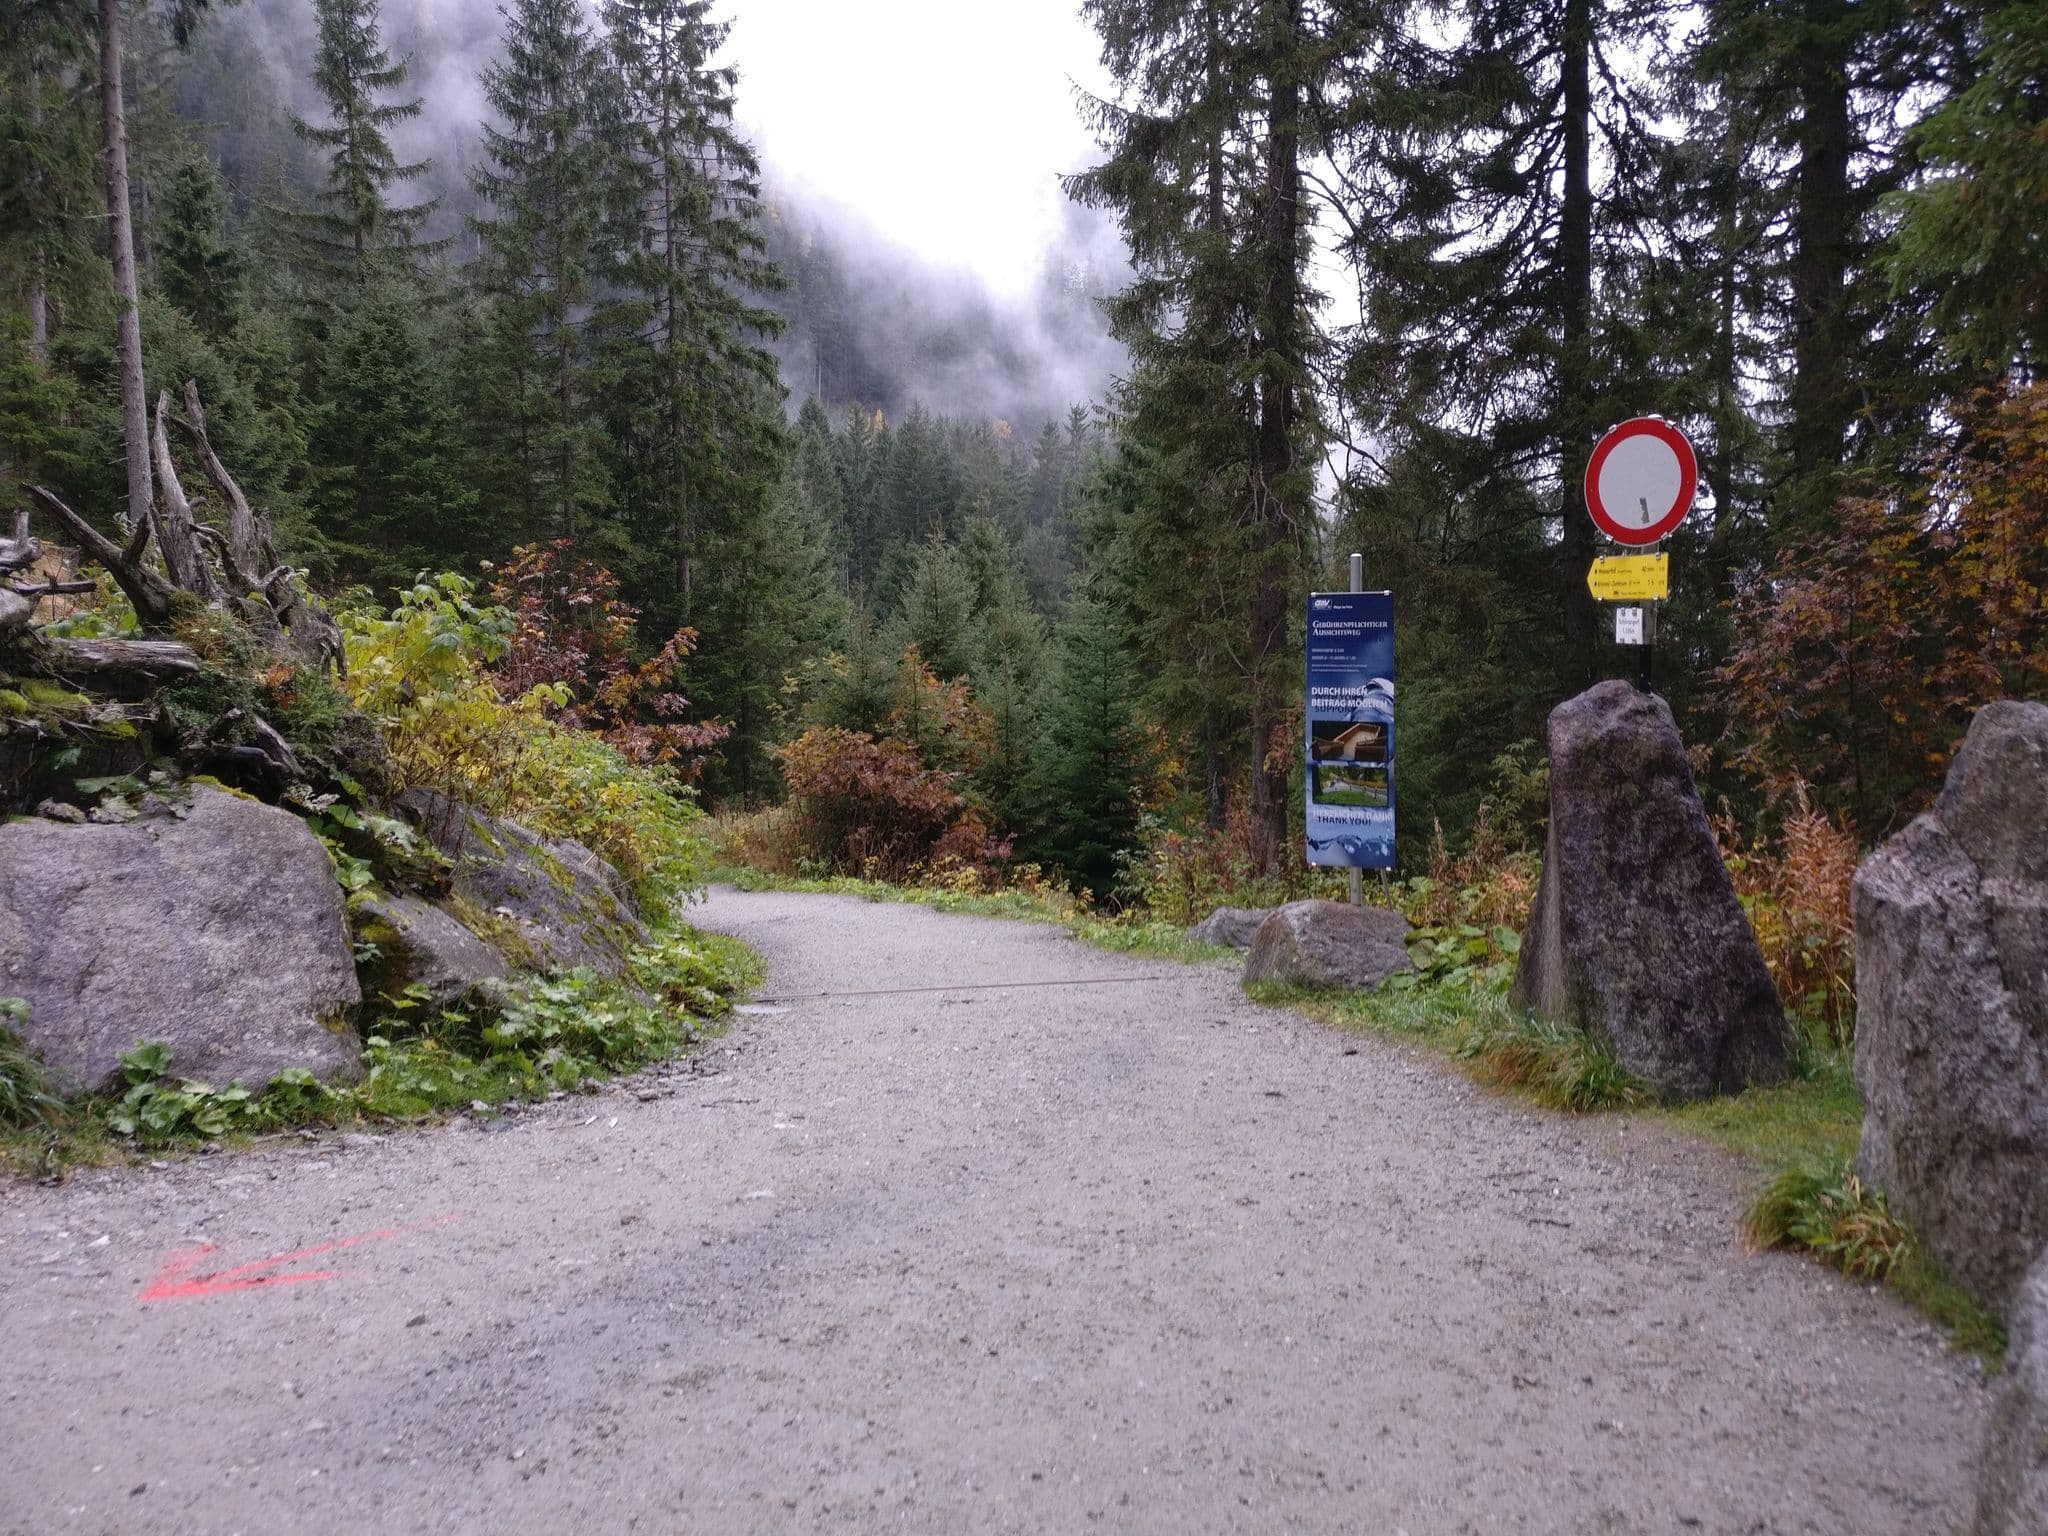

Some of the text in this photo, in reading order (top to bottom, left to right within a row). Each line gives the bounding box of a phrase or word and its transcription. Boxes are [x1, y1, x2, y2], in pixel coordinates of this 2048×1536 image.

[1311, 687, 1368, 695] DURCH IHREN
[1311, 698, 1346, 707] BEITRAG
[1318, 816, 1348, 825] THANK
